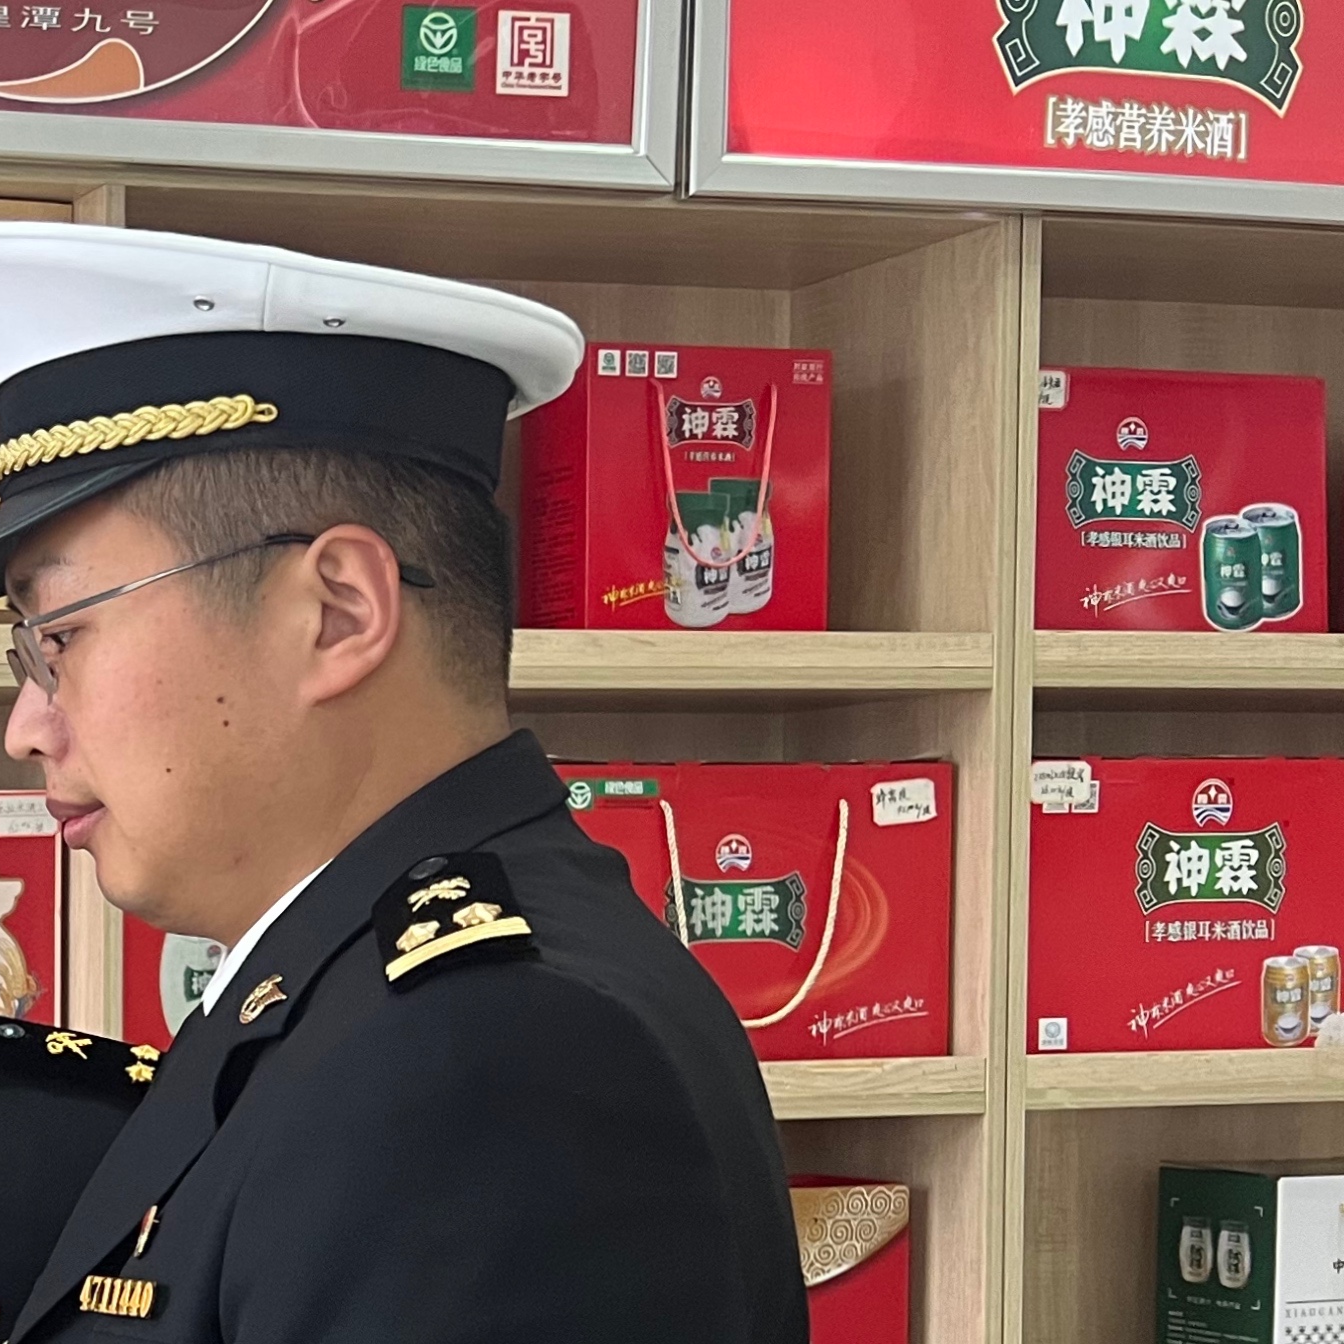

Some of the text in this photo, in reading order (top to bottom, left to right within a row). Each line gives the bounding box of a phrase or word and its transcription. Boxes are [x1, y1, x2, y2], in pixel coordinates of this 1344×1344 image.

[682, 407, 740, 440] 神霖
[1090, 466, 1177, 516] 神霖
[1164, 839, 1259, 896] 神霖
[690, 886, 780, 938] 神霖
